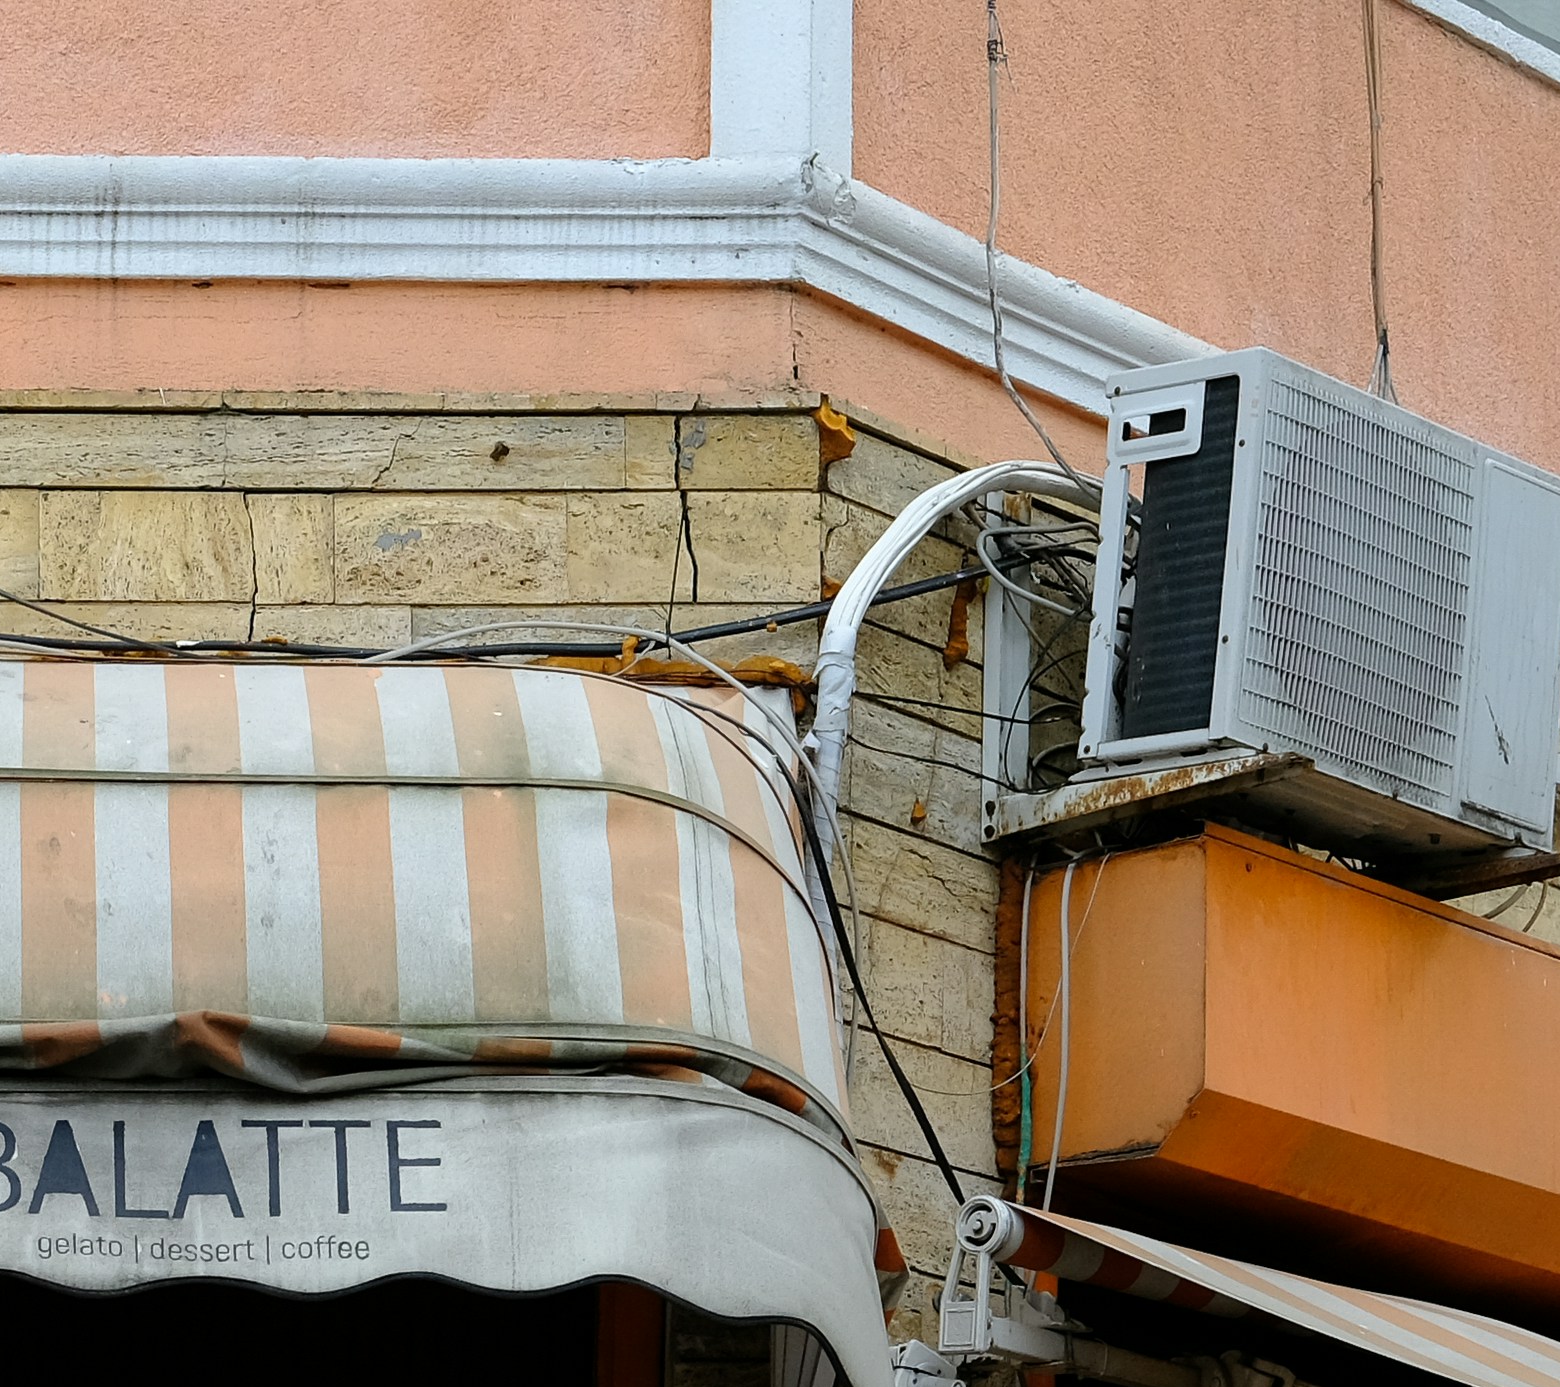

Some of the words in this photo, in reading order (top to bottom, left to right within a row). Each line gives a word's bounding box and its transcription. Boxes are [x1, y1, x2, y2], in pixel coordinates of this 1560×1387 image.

[36, 1234, 124, 1260] gelato
[149, 1238, 256, 1263] dessert
[281, 1235, 371, 1261] coffee
